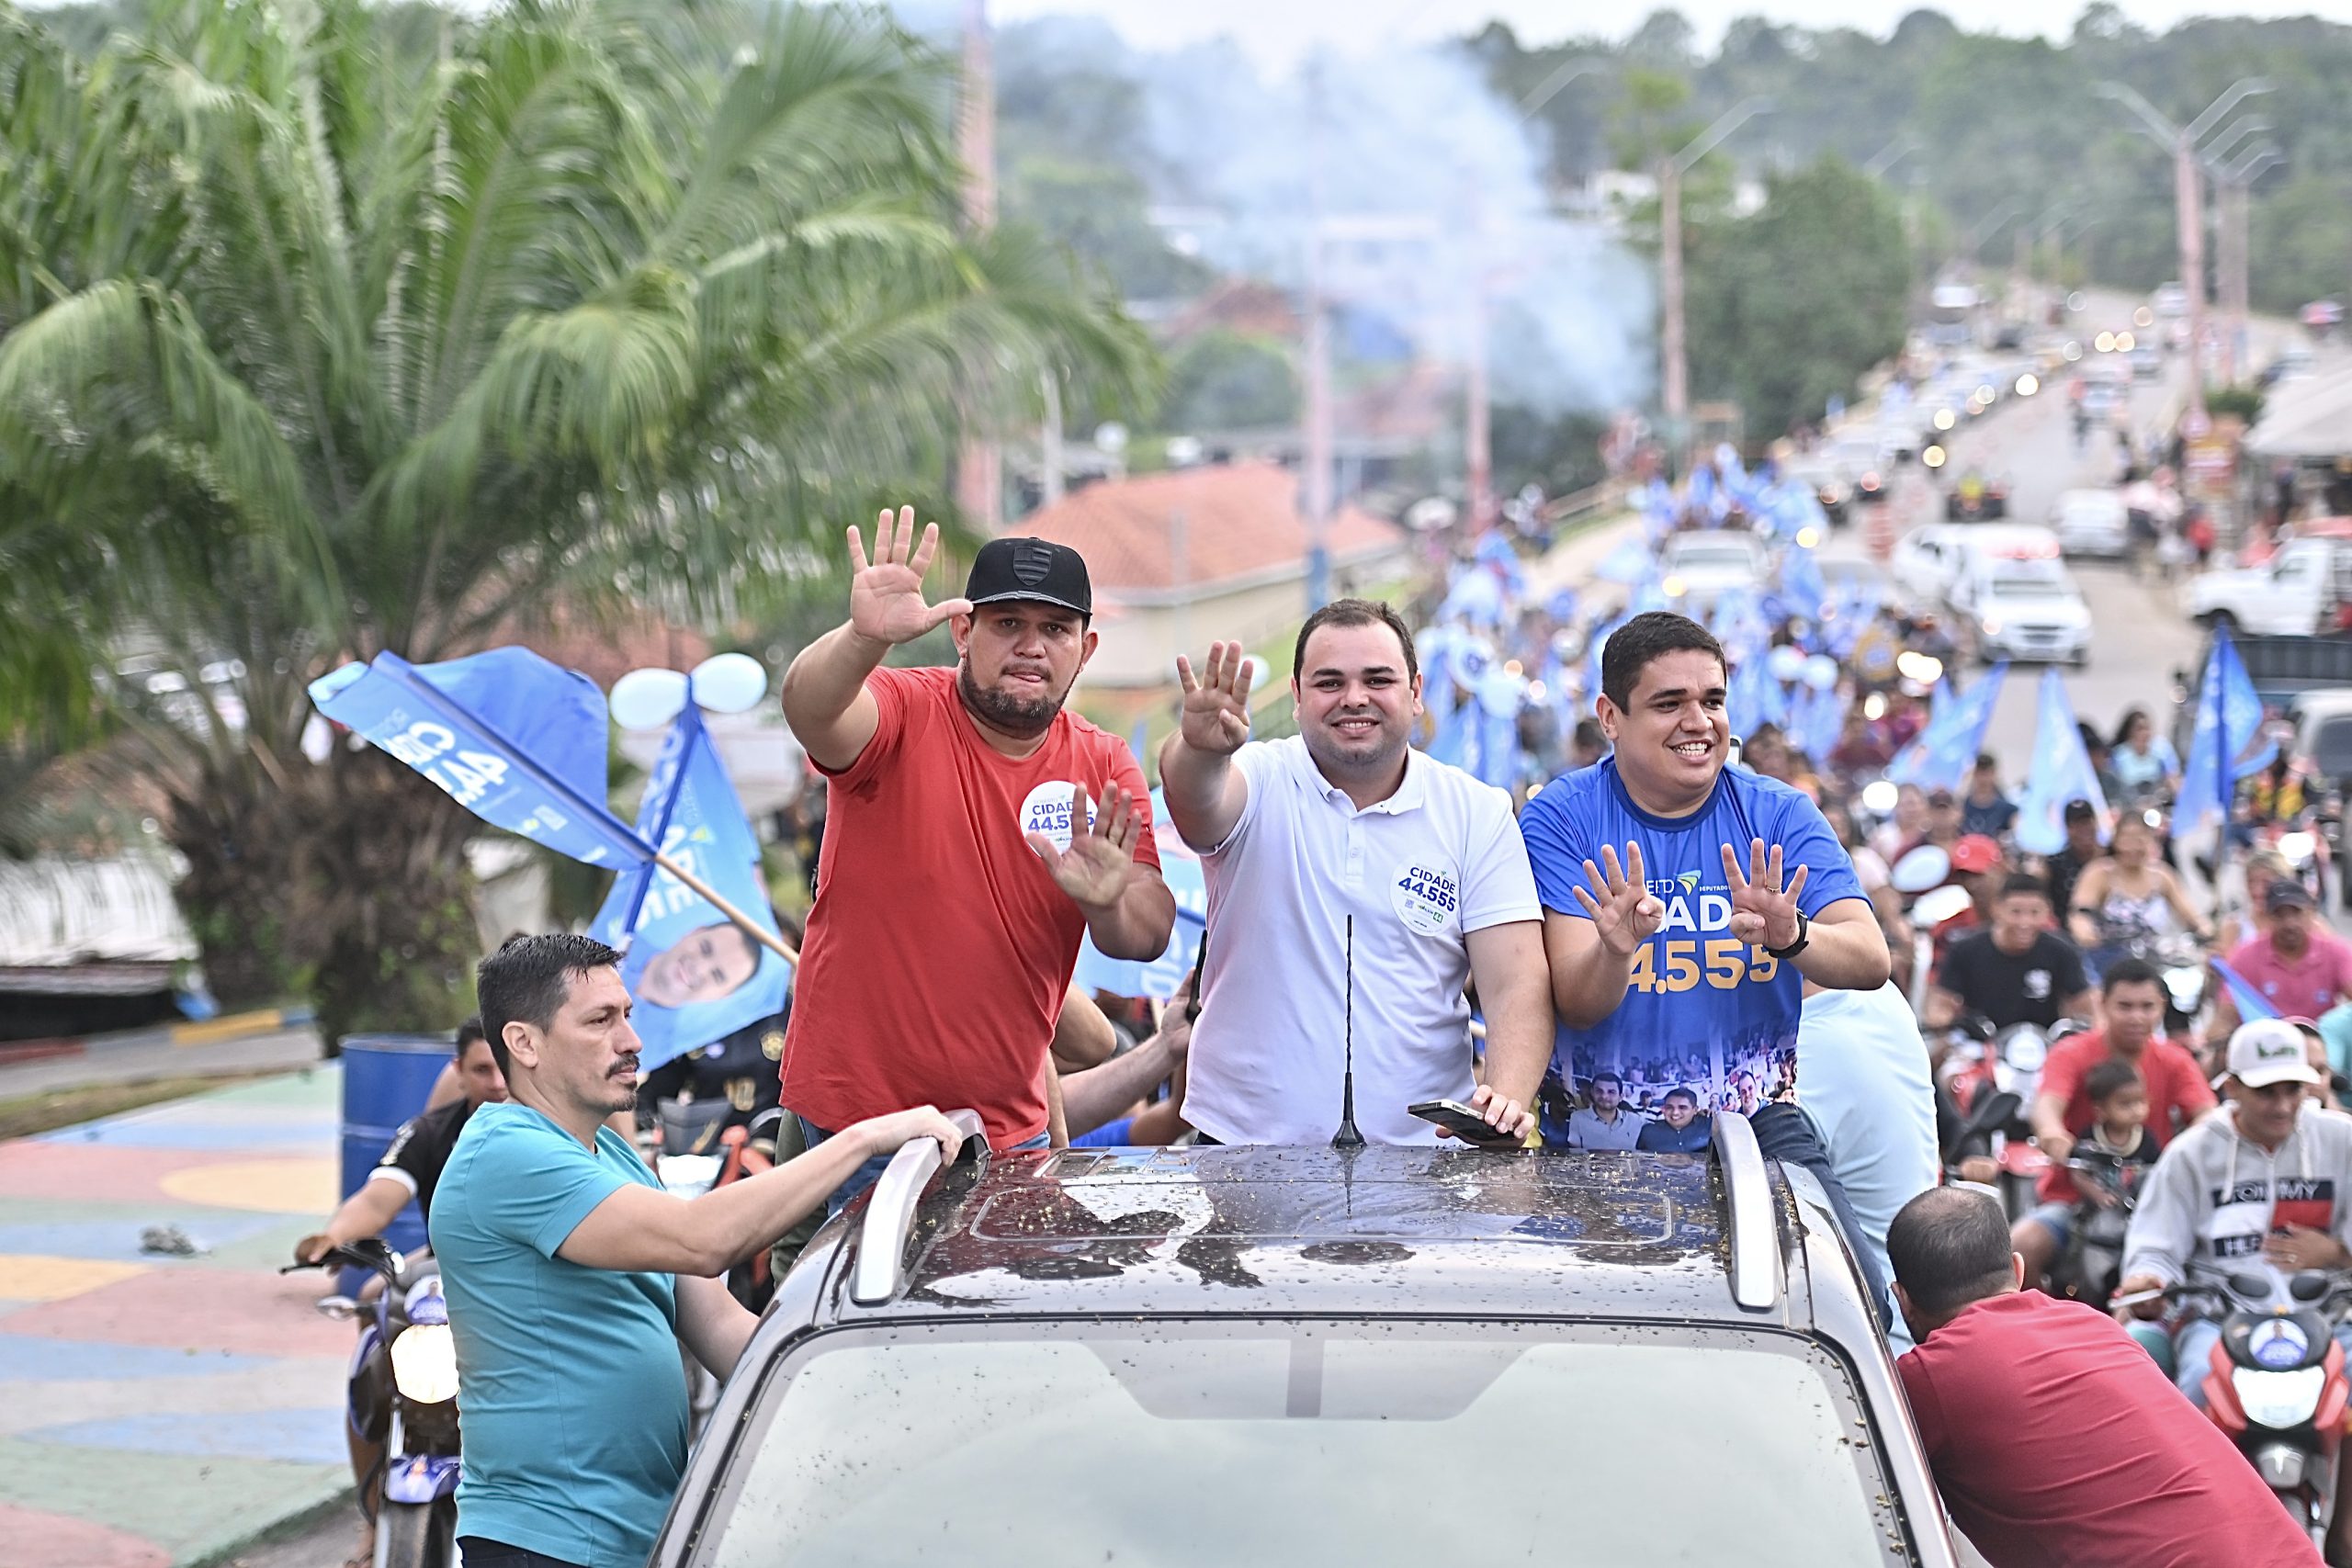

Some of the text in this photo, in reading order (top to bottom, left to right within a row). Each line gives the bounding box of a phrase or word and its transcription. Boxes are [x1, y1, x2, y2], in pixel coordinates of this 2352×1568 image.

[1032, 801, 1073, 816] CIDAD
[1397, 876, 1456, 912] 44.555
[1409, 866, 1456, 895] CIDADE
[1628, 938, 1779, 995] 4.555
